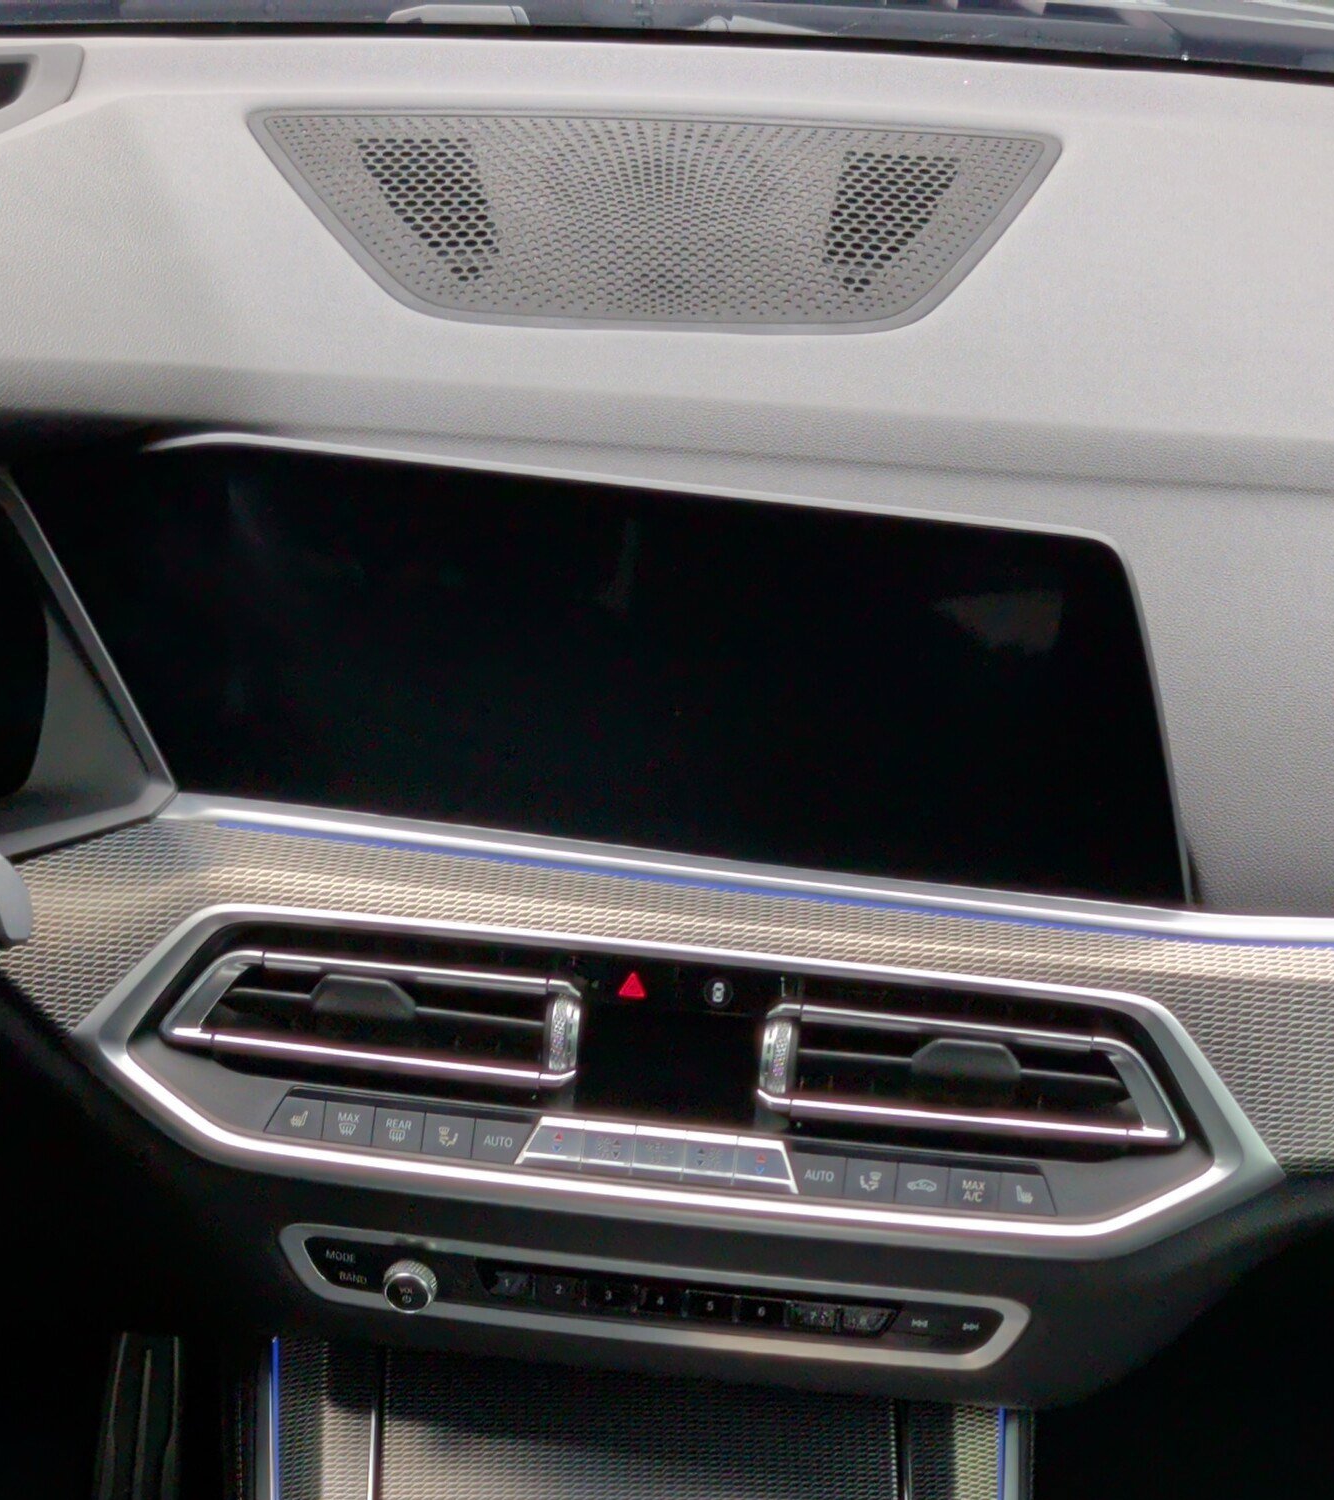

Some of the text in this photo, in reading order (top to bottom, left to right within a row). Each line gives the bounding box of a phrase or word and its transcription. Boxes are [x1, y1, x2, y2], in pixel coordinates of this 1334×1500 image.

[337, 1111, 360, 1123] MAX
[385, 1118, 412, 1131] REAR
[483, 1134, 513, 1148] AUTO
[804, 1168, 835, 1183] AUTO
[961, 1179, 986, 1191] MAX
[962, 1190, 983, 1203] A/C
[325, 1250, 356, 1264] MODE
[339, 1271, 367, 1285] BAND
[555, 1284, 563, 1295] 2
[605, 1290, 613, 1301] 3
[707, 1300, 715, 1311] 5
[757, 1306, 766, 1317] 6
